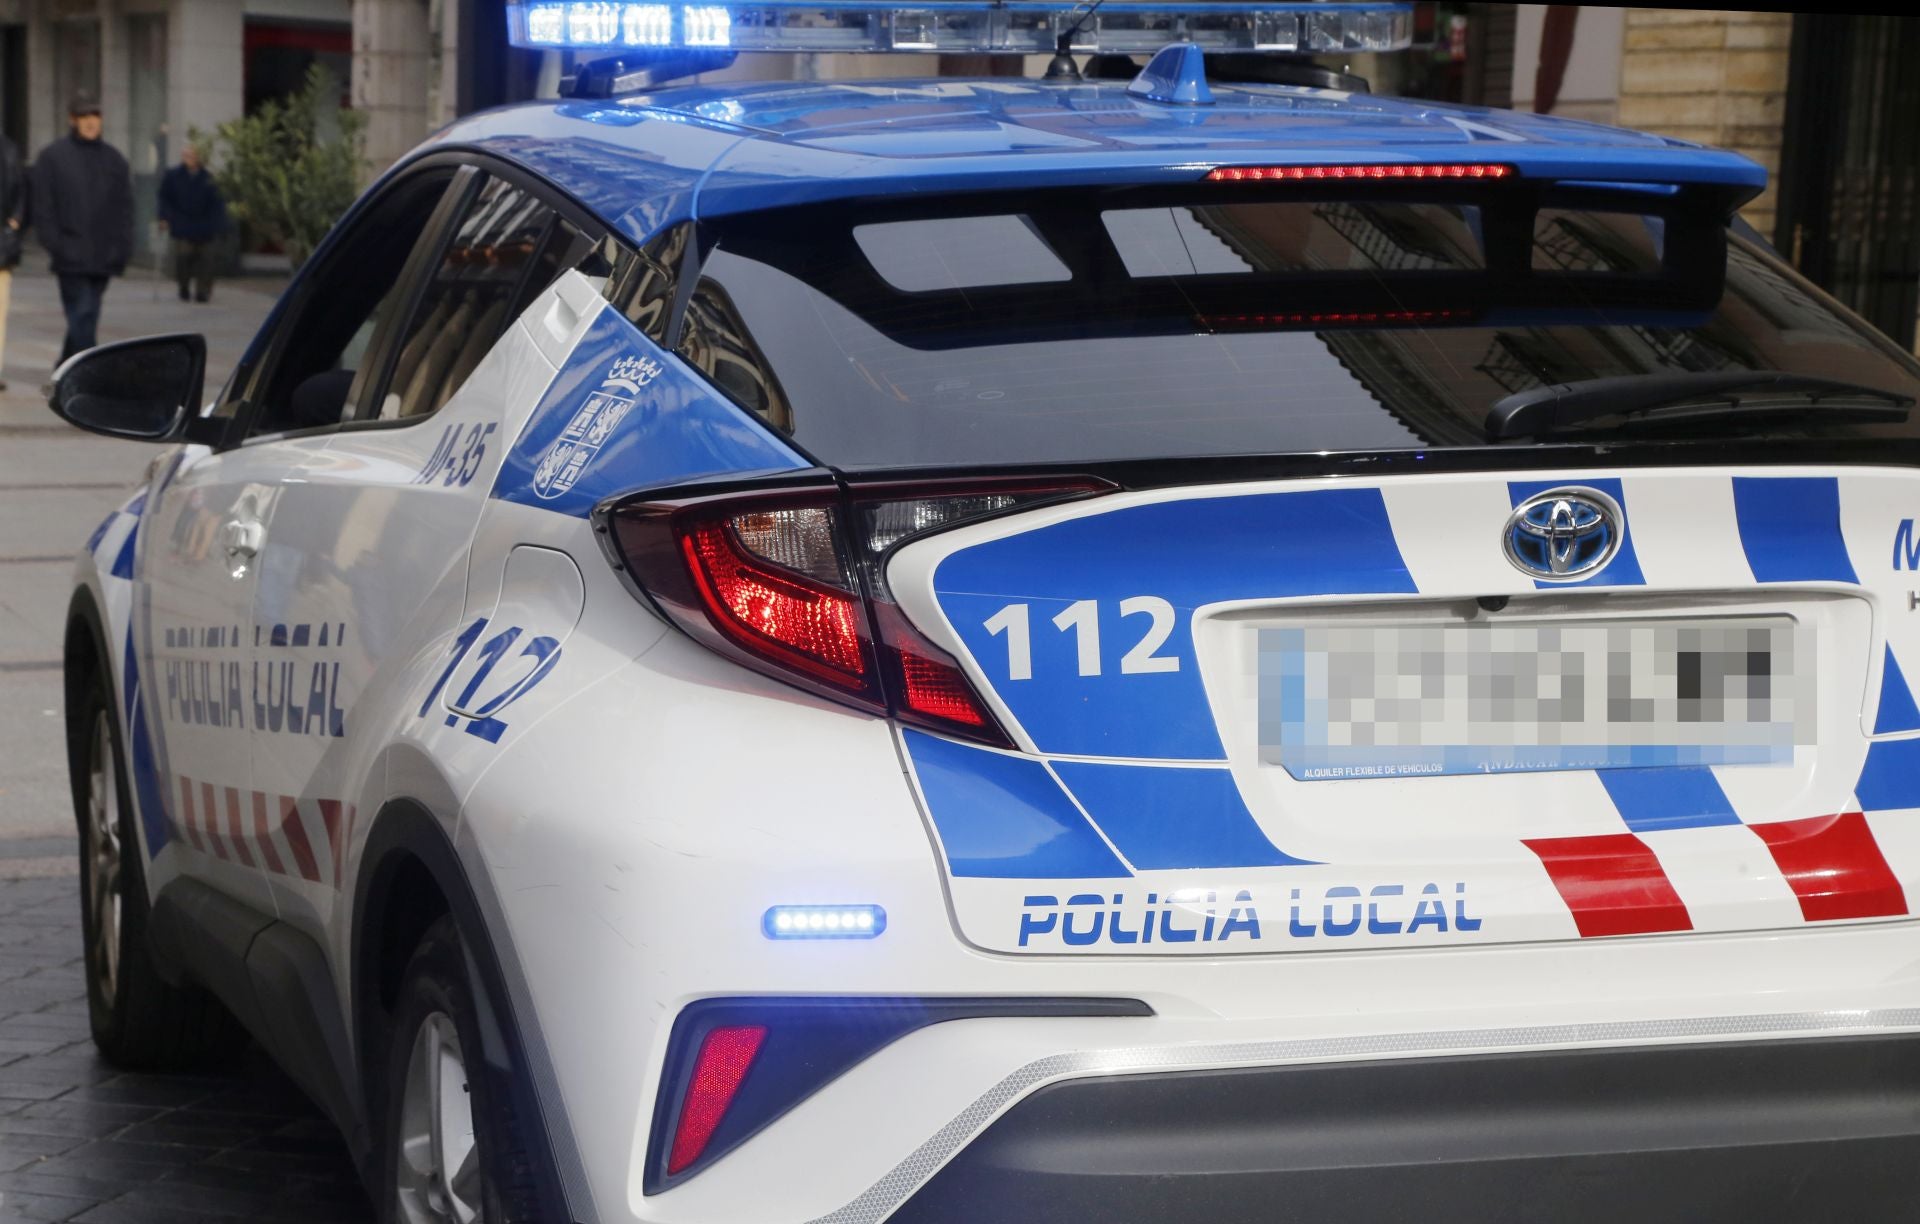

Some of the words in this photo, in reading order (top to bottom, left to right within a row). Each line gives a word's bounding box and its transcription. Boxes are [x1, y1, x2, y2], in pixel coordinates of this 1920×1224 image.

[409, 422, 498, 487] M-35
[983, 595, 1180, 681] 112
[166, 624, 244, 729] POLICIA
[253, 621, 345, 738] LOCAL
[417, 617, 563, 745] 112
[1304, 767, 1344, 778] ALQUILER
[1345, 765, 1383, 776] FLEXIBLE
[1385, 764, 1396, 774] DE
[1018, 889, 1261, 947] POLICIA
[1289, 882, 1482, 938] LOCAL
